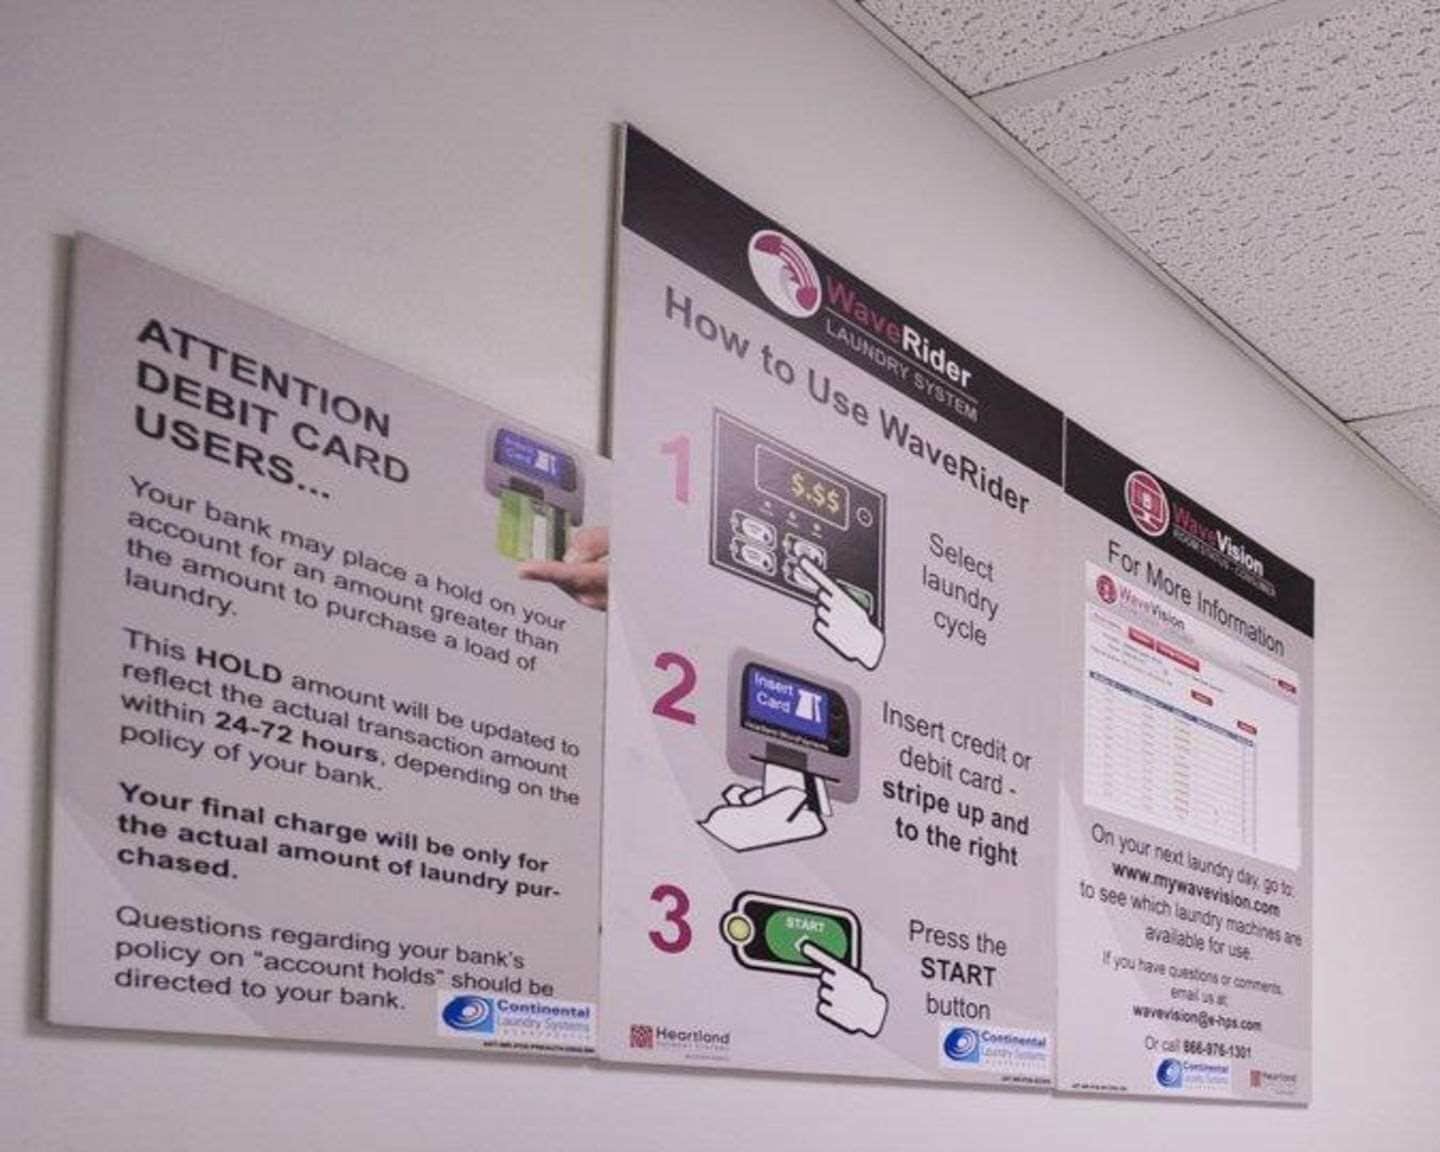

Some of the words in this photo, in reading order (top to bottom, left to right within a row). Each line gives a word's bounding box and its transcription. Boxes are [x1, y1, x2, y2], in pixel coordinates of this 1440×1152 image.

[826, 276, 972, 389] WaveRider
[137, 319, 389, 438] ATTENTION
[664, 286, 750, 359] How
[761, 344, 796, 384] to
[807, 367, 869, 425] Use
[880, 409, 1030, 514] WaveRider
[826, 319, 908, 384] LAUNDRY
[914, 373, 979, 422] SYSTEM
[137, 360, 278, 434] DEBIT
[292, 422, 409, 483] CARD
[135, 405, 329, 499] USERS...
[660, 431, 691, 505] 1
[130, 476, 196, 513] Your
[205, 500, 271, 538] bank
[281, 530, 335, 561] may
[343, 550, 407, 581] place
[414, 574, 428, 588] a
[437, 576, 483, 605] hold
[490, 597, 515, 616] on
[523, 608, 566, 630] your
[929, 532, 994, 579] Select
[1174, 504, 1264, 577] WaveVision
[126, 567, 236, 617] laundry.
[127, 538, 172, 567] the
[182, 558, 285, 600] amount
[294, 588, 318, 609] to
[326, 600, 436, 643] purchase
[444, 635, 457, 649] a
[465, 637, 510, 664] load
[516, 656, 536, 671] of
[128, 511, 241, 559] account
[250, 544, 285, 570] for
[294, 563, 325, 583] an
[334, 575, 423, 613] amount
[430, 605, 508, 638] greater
[515, 628, 559, 654] than
[922, 568, 999, 620] laundry
[1107, 540, 1141, 577] For
[1147, 562, 1191, 606] More
[1197, 589, 1285, 657] Information
[934, 611, 987, 646] cycle
[123, 628, 186, 661] This
[196, 646, 282, 683] HOLD
[291, 676, 385, 710] amount
[392, 700, 428, 720] will
[437, 707, 464, 729] be
[471, 720, 555, 751] updated
[561, 739, 580, 757] to
[651, 651, 698, 725] 2
[754, 672, 794, 697] Insert
[756, 692, 791, 713] Card
[121, 694, 205, 725] within
[215, 711, 293, 744] 24-72
[302, 730, 385, 766] hours,
[394, 752, 511, 795] depending
[517, 782, 543, 797] on
[550, 785, 580, 806] the
[123, 664, 212, 698] reflect
[222, 684, 263, 708] the
[272, 700, 349, 728] actual
[358, 715, 483, 759] transaction
[490, 750, 567, 779] amount
[882, 701, 946, 742] Insert
[951, 729, 1007, 764] credit
[1012, 750, 1032, 770] or
[120, 725, 205, 759] policy
[214, 743, 241, 761] of
[249, 751, 307, 775] your
[315, 761, 381, 790] bank.
[900, 747, 954, 782] debit
[959, 766, 1004, 795] card
[120, 782, 192, 812] Your
[201, 797, 264, 825] final
[274, 813, 367, 844] charge
[376, 832, 418, 851] will
[426, 837, 454, 856] be
[462, 848, 511, 870] only
[518, 853, 549, 872] for
[882, 777, 951, 814] stripe
[957, 801, 985, 825] up
[991, 807, 1030, 836] and
[117, 847, 237, 879] chased.
[118, 814, 167, 838] the
[178, 827, 267, 854] actual
[277, 844, 380, 872] amount
[388, 859, 413, 876] of
[421, 862, 508, 894] laundry
[516, 882, 560, 897] pur-
[895, 817, 919, 841] to
[926, 825, 962, 852] the
[968, 836, 1019, 866] right
[1091, 822, 1114, 846] On
[1119, 834, 1151, 856] your
[1155, 845, 1184, 867] next
[1187, 853, 1233, 884] laundry
[1264, 877, 1278, 896] go
[1080, 880, 1095, 899] to
[1100, 888, 1127, 908] see
[1130, 893, 1172, 917] which
[1175, 903, 1223, 932] laundry
[1226, 914, 1280, 942] machines
[1284, 930, 1302, 947] are
[1112, 860, 1280, 917] www.mywavevision.com
[116, 906, 262, 940] Questions
[271, 928, 390, 959] regarding
[399, 943, 449, 960] your
[456, 945, 524, 969] bank's
[648, 884, 692, 953] 3
[785, 917, 827, 933] START
[909, 919, 971, 951] Press
[977, 933, 1008, 957] the
[1145, 925, 1204, 951] available
[1208, 936, 1224, 954] for
[115, 968, 231, 995] directed
[241, 979, 266, 998] to
[275, 986, 333, 1004] your
[340, 987, 405, 1009] bank.
[116, 941, 201, 967] policy
[210, 951, 244, 967] on
[253, 951, 364, 979] "account
[373, 963, 441, 986] holds"
[452, 973, 521, 994] should
[529, 979, 554, 997] be
[921, 958, 997, 987] START
[1113, 954, 1135, 971] you
[1137, 958, 1165, 976] have
[1169, 963, 1218, 986] questions
[1221, 971, 1231, 985] or
[1171, 986, 1199, 1001] email
[497, 1000, 590, 1019] Continental
[656, 1026, 730, 1044] Heartland
[927, 996, 991, 1020] button
[982, 1030, 1046, 1047] Continental
[1144, 1035, 1160, 1050] Or
[1162, 1036, 1180, 1053] call
[1183, 1060, 1229, 1074] Continental
